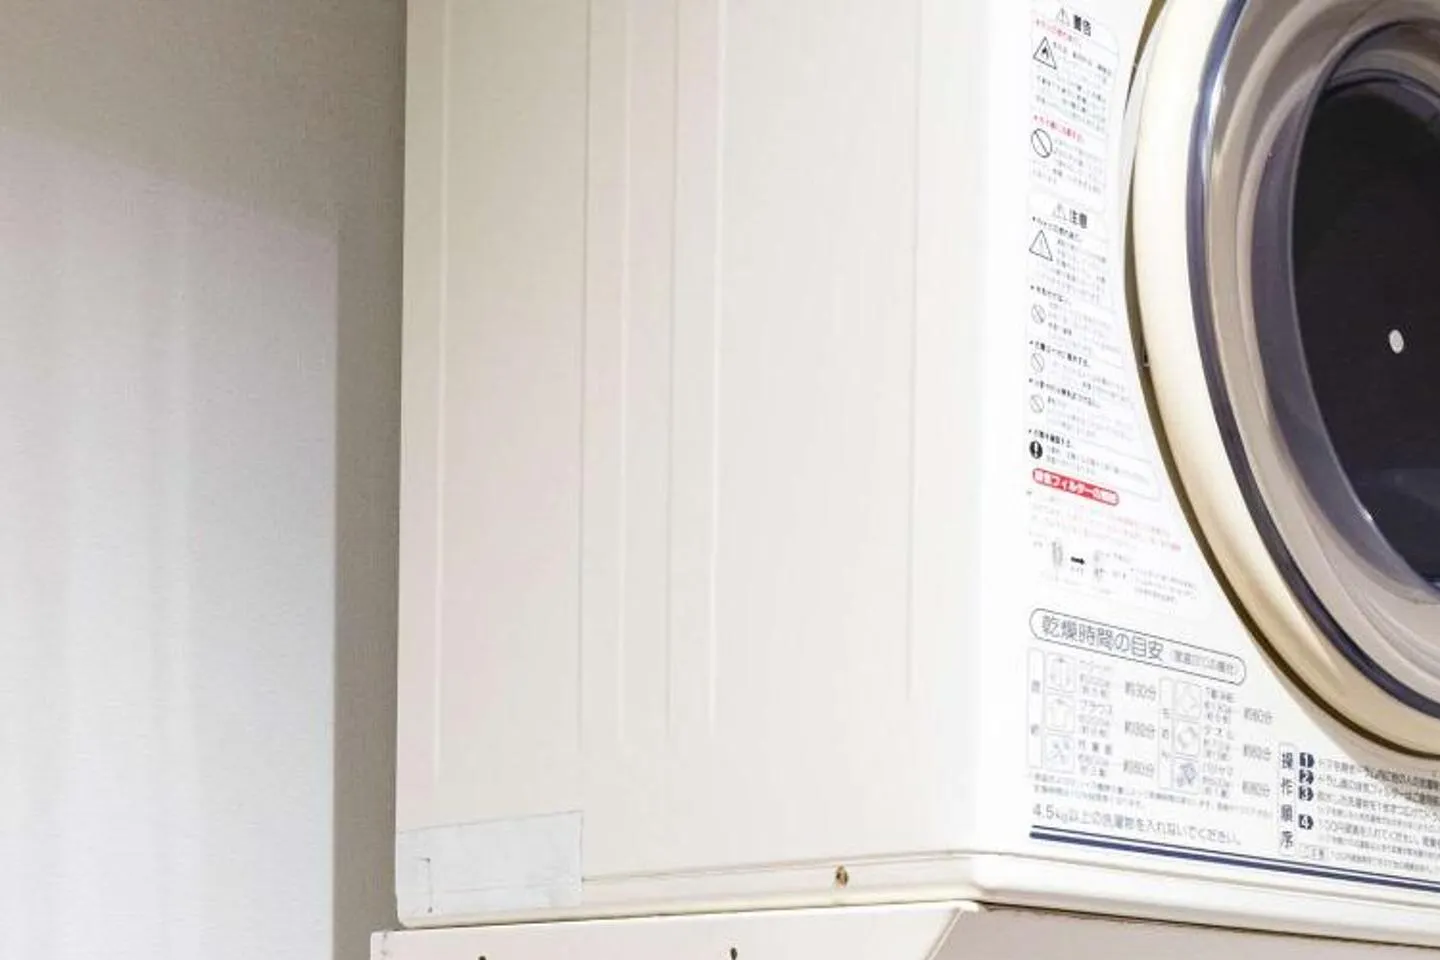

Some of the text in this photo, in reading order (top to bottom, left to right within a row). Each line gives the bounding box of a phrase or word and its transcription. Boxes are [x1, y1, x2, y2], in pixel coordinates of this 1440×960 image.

[1041, 614, 1165, 662] 乾燥時間の目安
